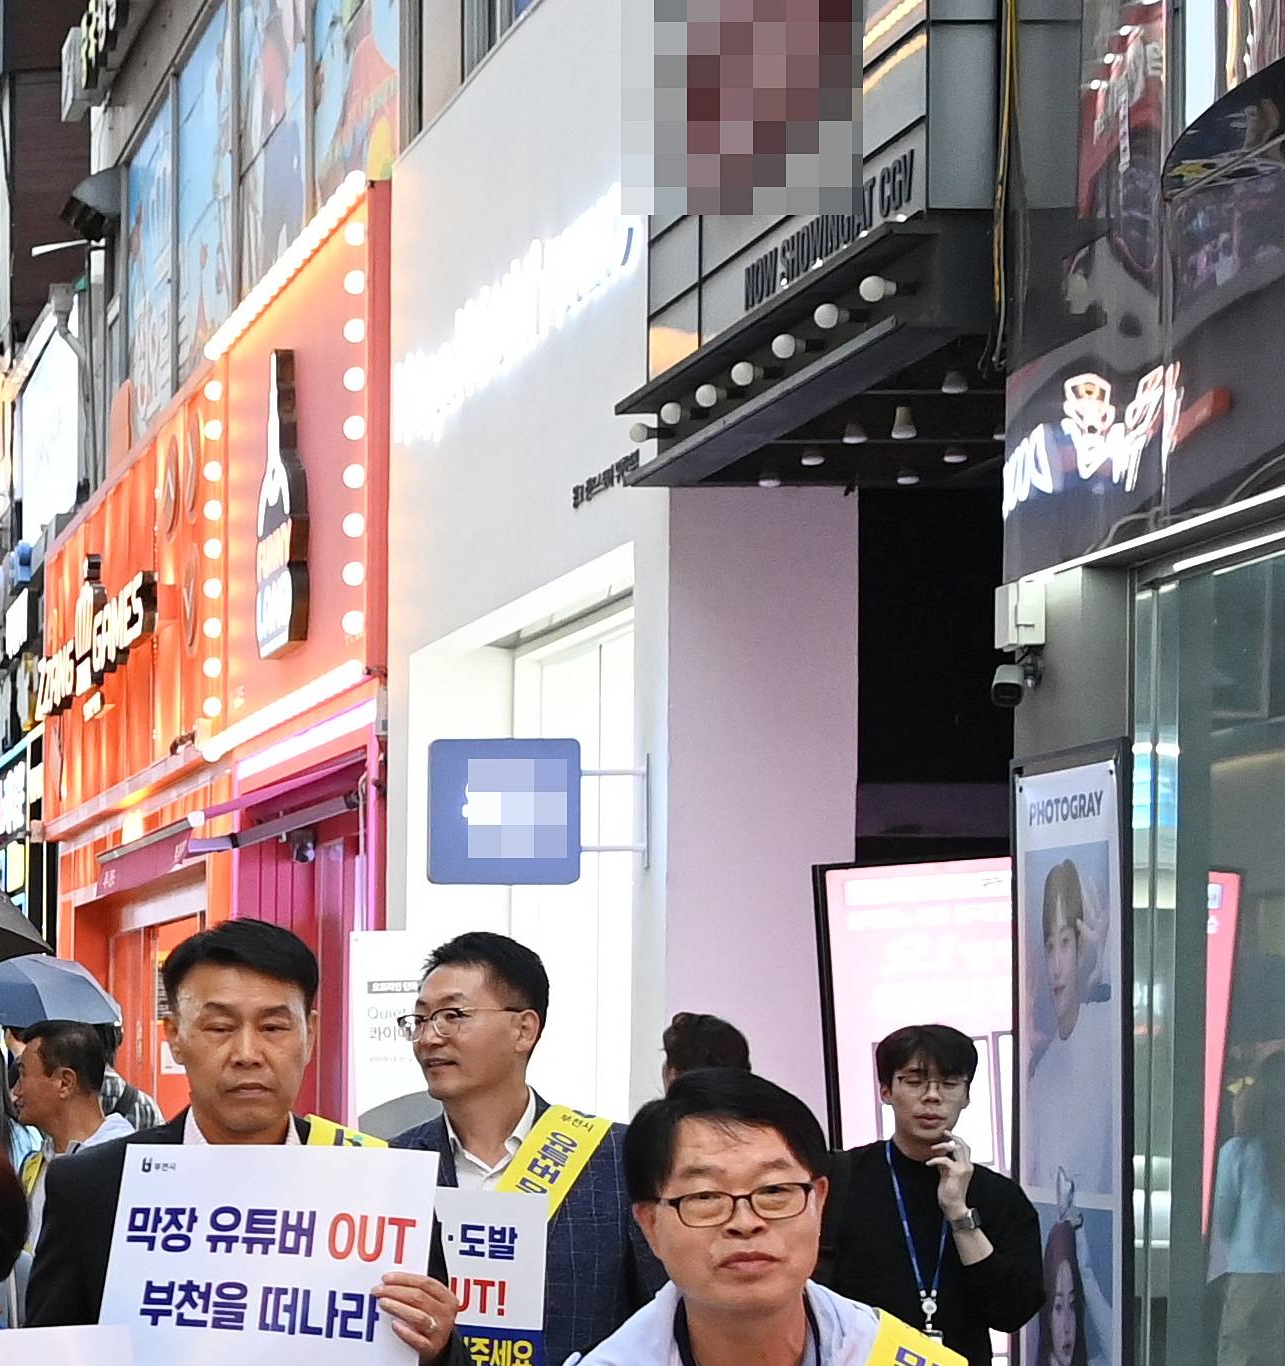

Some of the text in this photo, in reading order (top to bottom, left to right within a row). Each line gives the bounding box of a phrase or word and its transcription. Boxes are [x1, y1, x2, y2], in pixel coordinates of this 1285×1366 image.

[745, 247, 778, 311] NOW
[880, 149, 915, 218] CGV
[1029, 790, 1103, 827] PHOTOGRAY
[126, 1206, 417, 1264] 막장 유튜버 OUT
[139, 1279, 380, 1342] 부천을 떠나라
